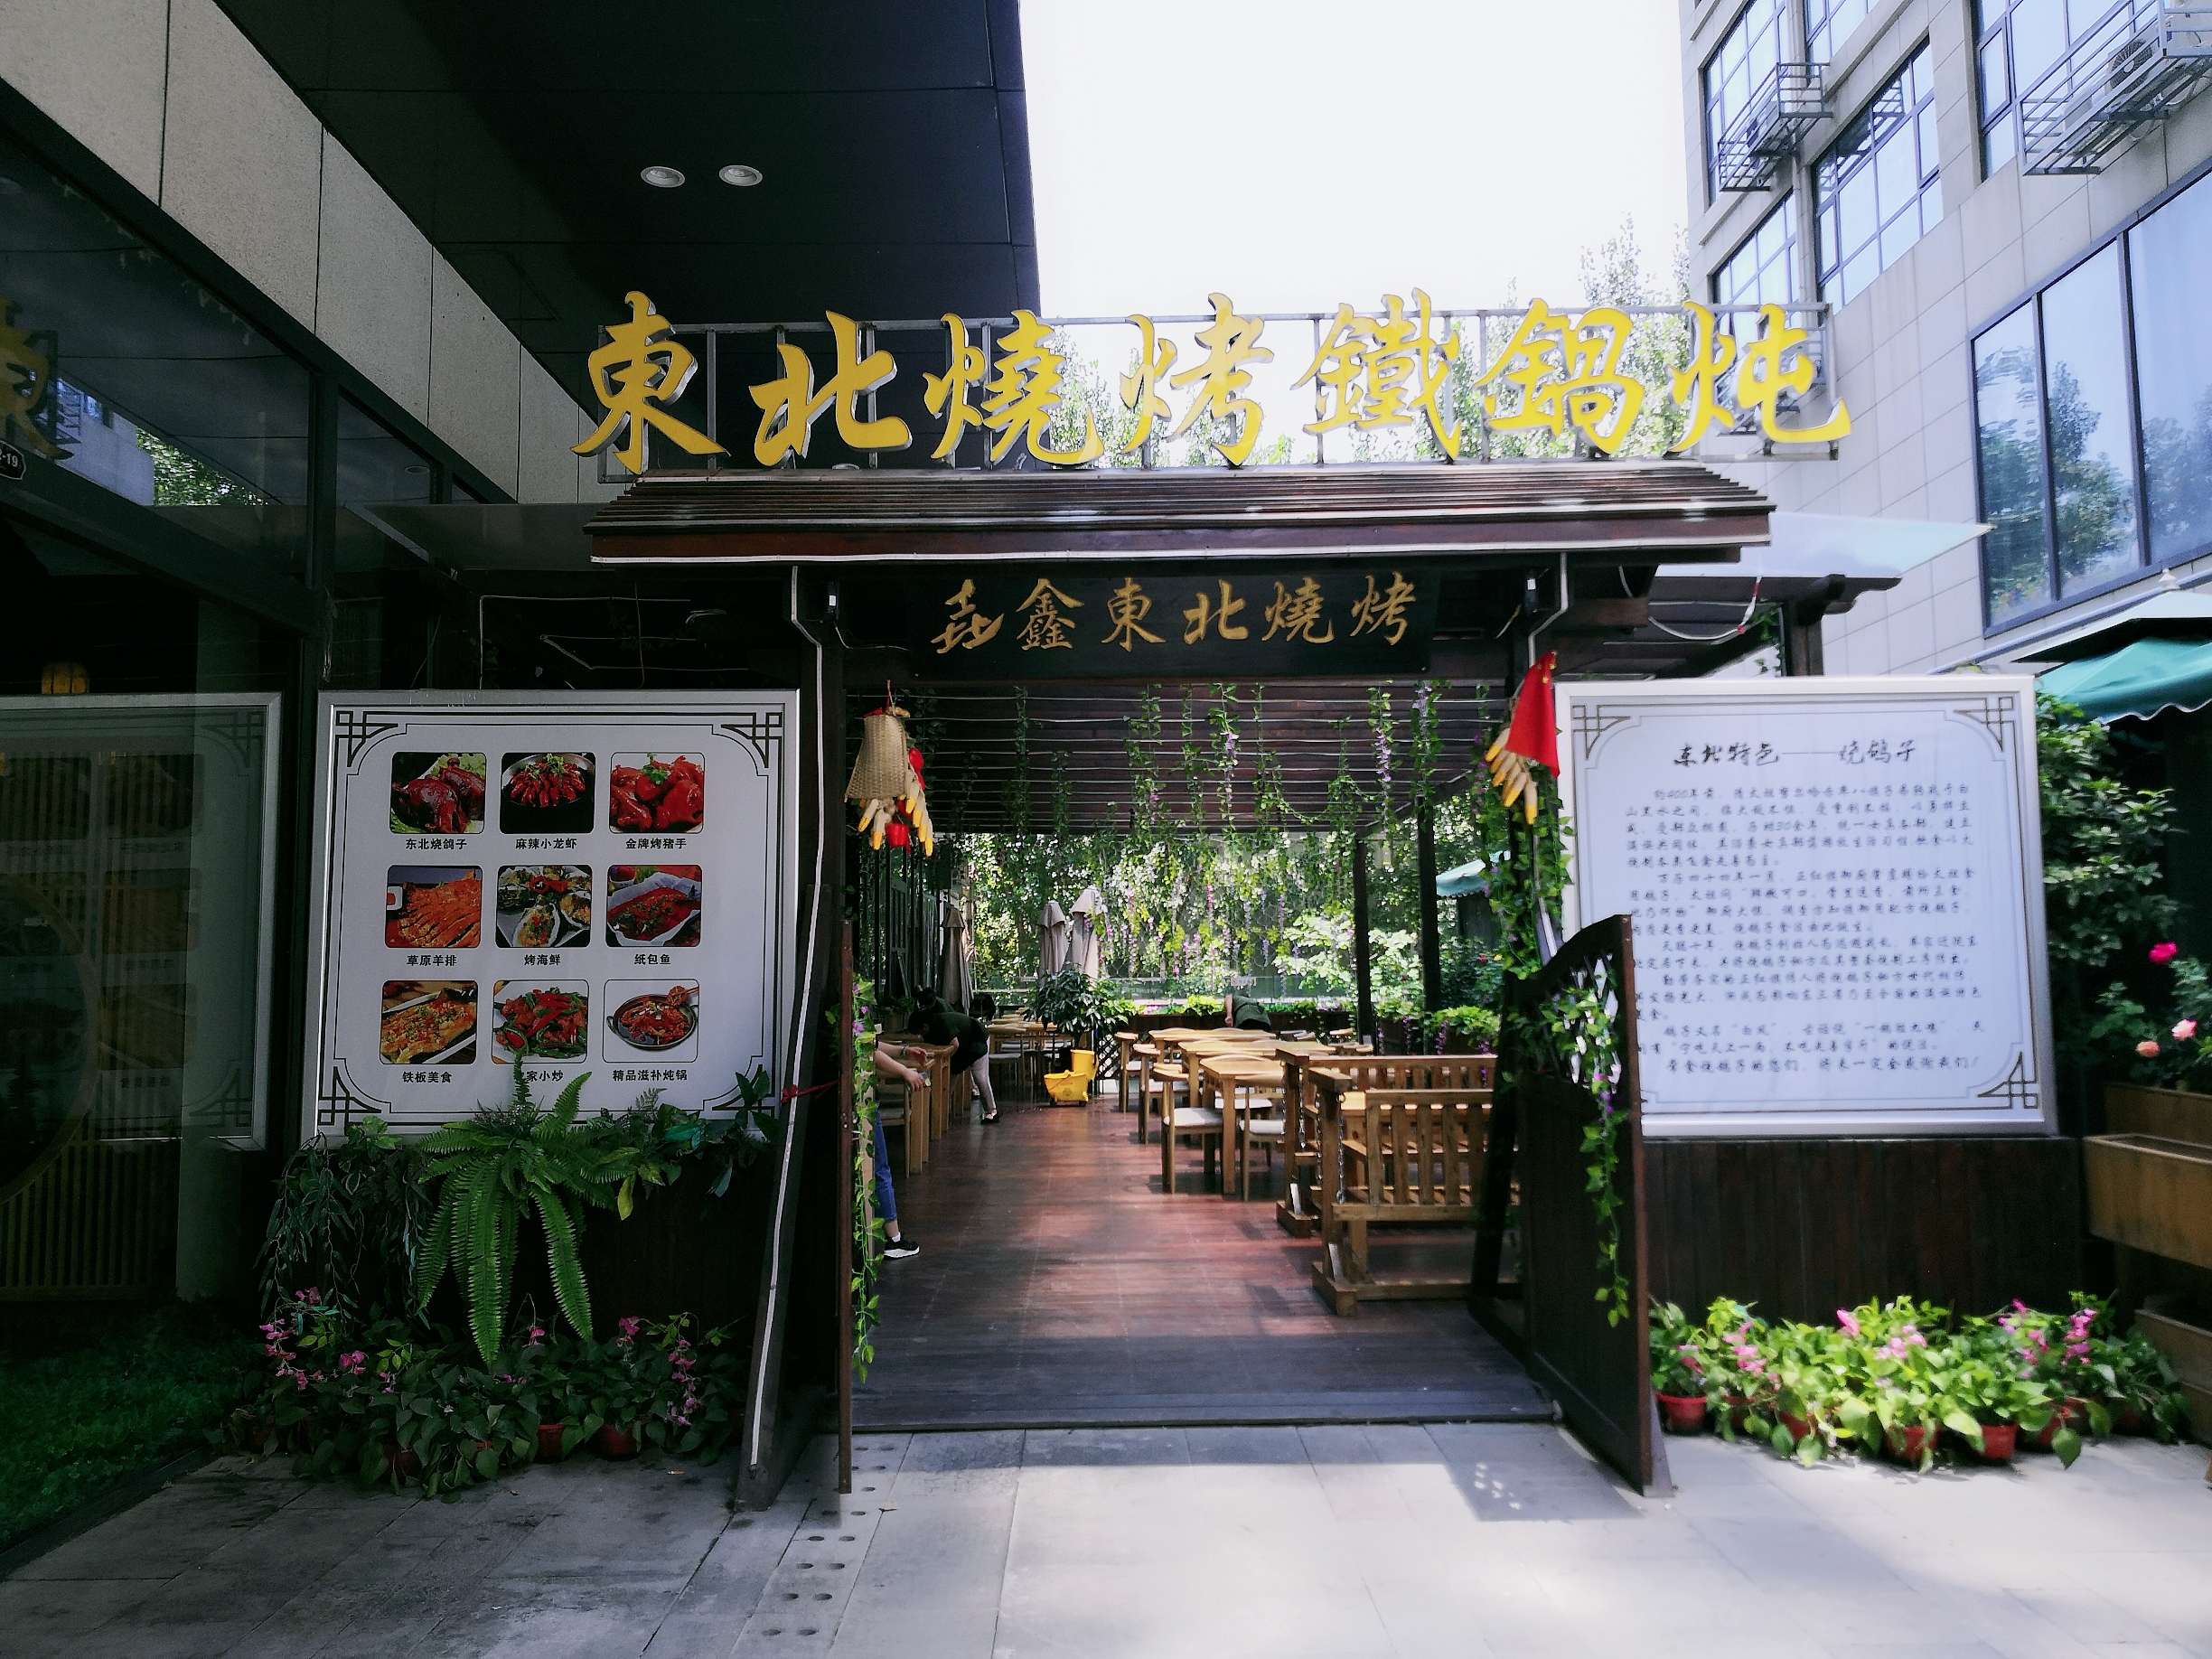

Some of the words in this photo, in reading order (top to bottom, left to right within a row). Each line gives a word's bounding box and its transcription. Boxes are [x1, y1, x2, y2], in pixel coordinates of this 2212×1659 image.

[0, 448, 18, 467] -19
[405, 838, 468, 850] 东北烧鸽子
[515, 838, 577, 850] 麻辣小龙虾
[625, 838, 688, 849] 金牌烤猪手
[406, 954, 457, 967] 草原羊排
[523, 953, 561, 966] 烤海鲜
[633, 953, 671, 965] 纸包鱼
[401, 1071, 453, 1083] 铁板美食
[612, 1069, 688, 1082] 精品滋补炖锅
